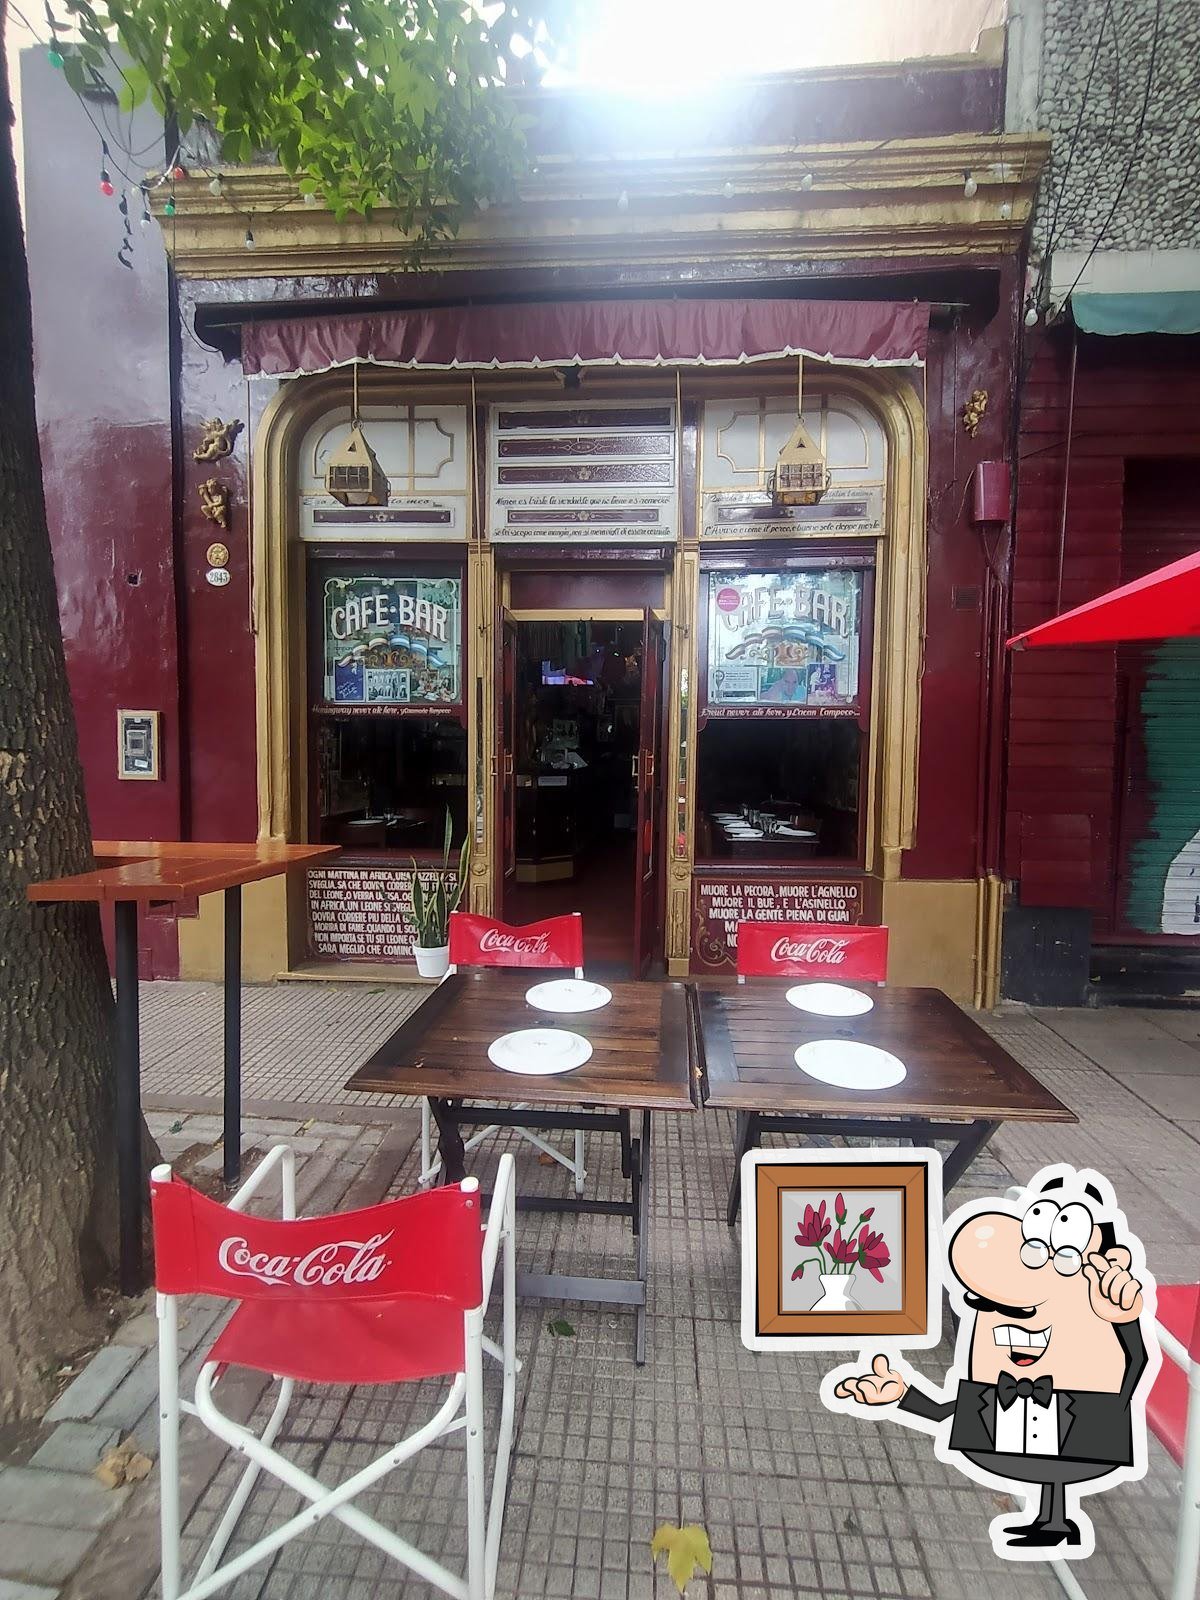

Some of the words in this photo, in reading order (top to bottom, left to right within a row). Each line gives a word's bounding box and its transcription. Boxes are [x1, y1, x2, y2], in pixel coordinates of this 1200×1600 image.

[209, 571, 228, 583] 2843
[726, 709, 750, 717] never
[307, 870, 327, 879] OGNI
[328, 870, 359, 880] MATTINA
[360, 871, 369, 880] IN
[347, 881, 362, 891] CHE
[700, 884, 729, 896] MUORE
[731, 885, 743, 896] LA
[779, 885, 810, 898] MUORE
[811, 884, 858, 899] L'AGNELLO
[309, 890, 322, 900] DEL
[360, 902, 384, 912] LEONE
[712, 897, 744, 908] MUORE
[747, 897, 756, 908] IL
[783, 898, 789, 909] E
[794, 898, 847, 910] L'ASINELLO
[312, 912, 336, 921] DOVRA
[337, 912, 367, 923] CORRERE
[380, 913, 402, 923] DELLA
[709, 908, 739, 919] MUORE
[741, 909, 754, 920] LA
[754, 909, 784, 921] GENTE
[786, 909, 814, 921] PIENA
[816, 909, 827, 921] DI
[827, 909, 850, 922] GUAI
[386, 934, 409, 945] LEONE
[318, 943, 338, 954] SARA
[339, 943, 366, 955] MEGLIO
[366, 944, 382, 955] CHE
[770, 936, 850, 964] Coca-Cola
[218, 1228, 395, 1287] Coca-Cola
